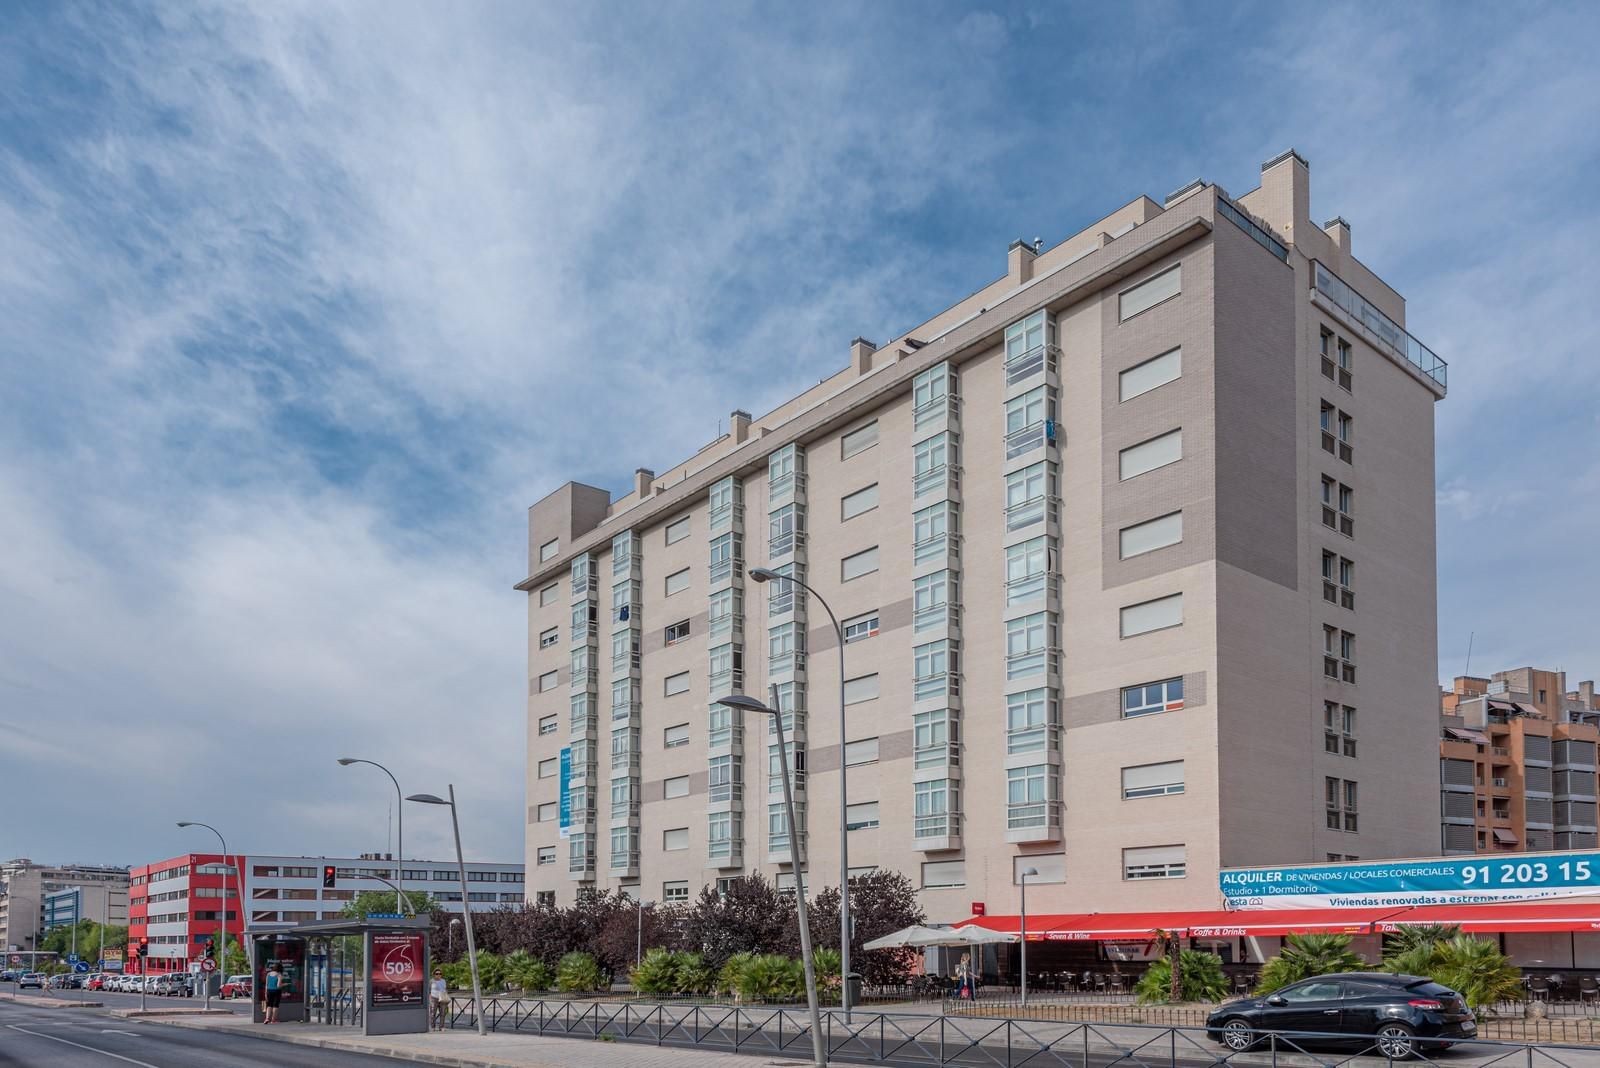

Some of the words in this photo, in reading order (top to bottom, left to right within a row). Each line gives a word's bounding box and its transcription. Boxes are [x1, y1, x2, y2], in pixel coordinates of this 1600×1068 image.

[1223, 872, 1282, 885] ALQUILER
[1299, 873, 1342, 881] VIVIENDAS
[1349, 870, 1388, 879] LOCALES
[1389, 867, 1455, 877] COMERCIALES
[1461, 865, 1489, 884] 91
[1500, 863, 1549, 883] 203
[1558, 861, 1592, 881] 15
[1223, 887, 1253, 896] Estudio
[1268, 885, 1318, 894] Dormitorio
[1226, 898, 1248, 906] esta
[1329, 898, 1379, 906] Viviendas
[1381, 896, 1437, 905] renovadas
[1440, 896, 1446, 904] a
[1193, 928, 1213, 936] Coffe
[1381, 923, 1400, 931] Tak
